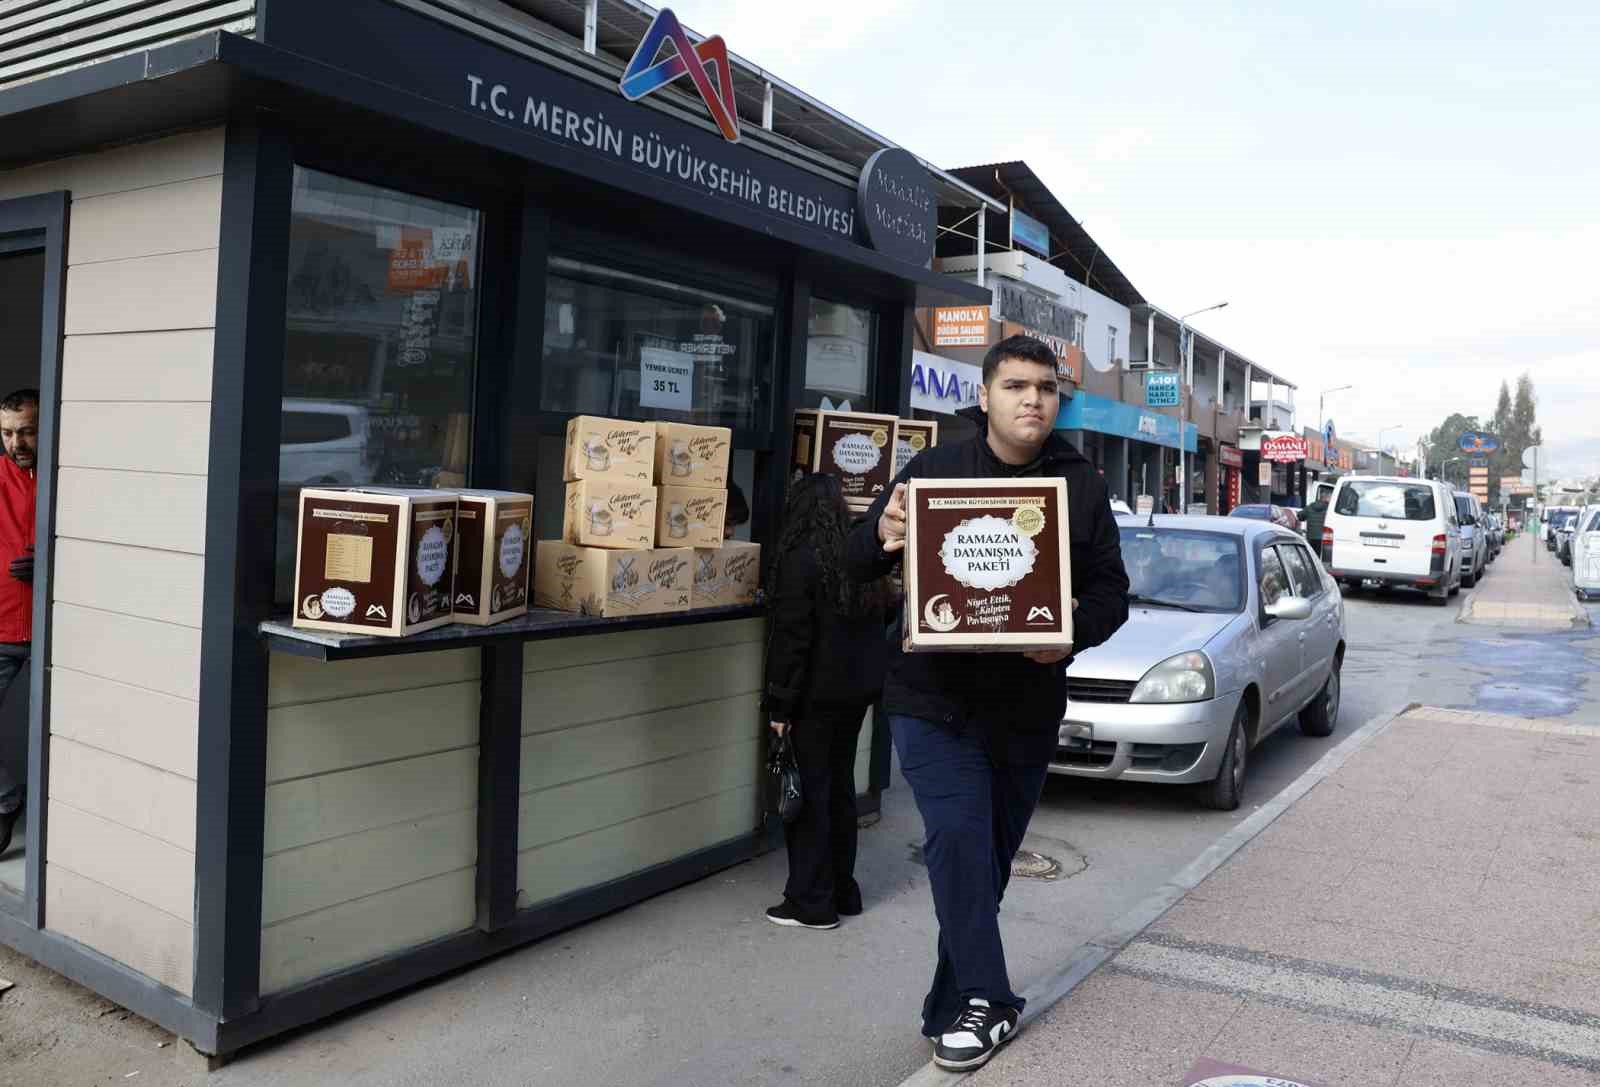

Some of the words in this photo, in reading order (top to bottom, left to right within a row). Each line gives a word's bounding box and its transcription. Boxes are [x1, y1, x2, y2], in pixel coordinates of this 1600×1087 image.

[467, 73, 515, 120] T.C.
[523, 96, 623, 156] MERSİN
[631, 132, 761, 204] BÜYÜKŞEHİR
[767, 186, 855, 236] BELEDİYESİ
[938, 310, 984, 322] MANOLYA
[653, 379, 666, 391] 35
[667, 381, 681, 393] TL
[957, 534, 1018, 544] RAMAZAN
[953, 547, 1023, 561] DAYANIŞMA
[968, 558, 1010, 571] PAKETİ
